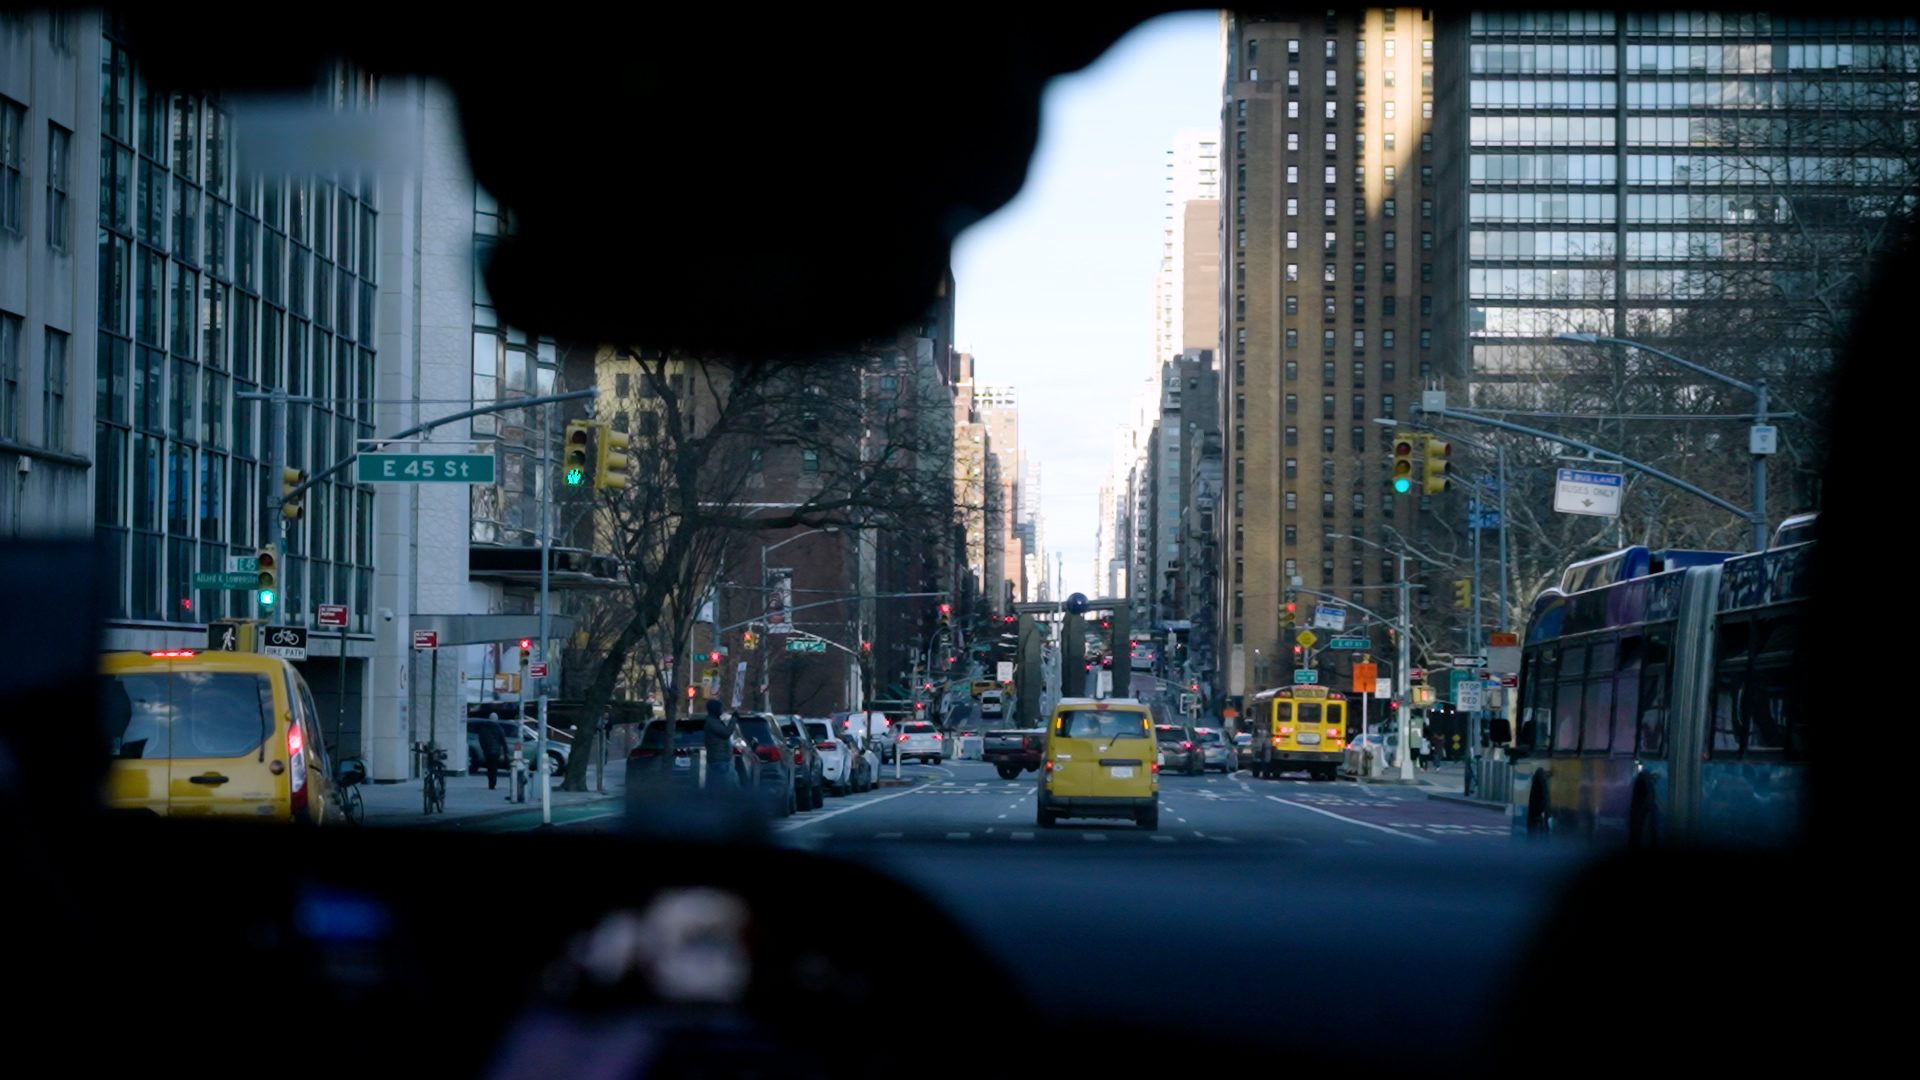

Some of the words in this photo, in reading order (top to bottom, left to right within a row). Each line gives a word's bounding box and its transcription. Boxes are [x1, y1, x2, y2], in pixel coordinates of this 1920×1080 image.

[383, 460, 396, 477] E
[404, 460, 435, 477] 45
[444, 460, 469, 478] St
[1574, 473, 1592, 484] BUS
[246, 559, 256, 570] 45
[285, 649, 304, 657] PATH
[1460, 683, 1480, 691] STOP
